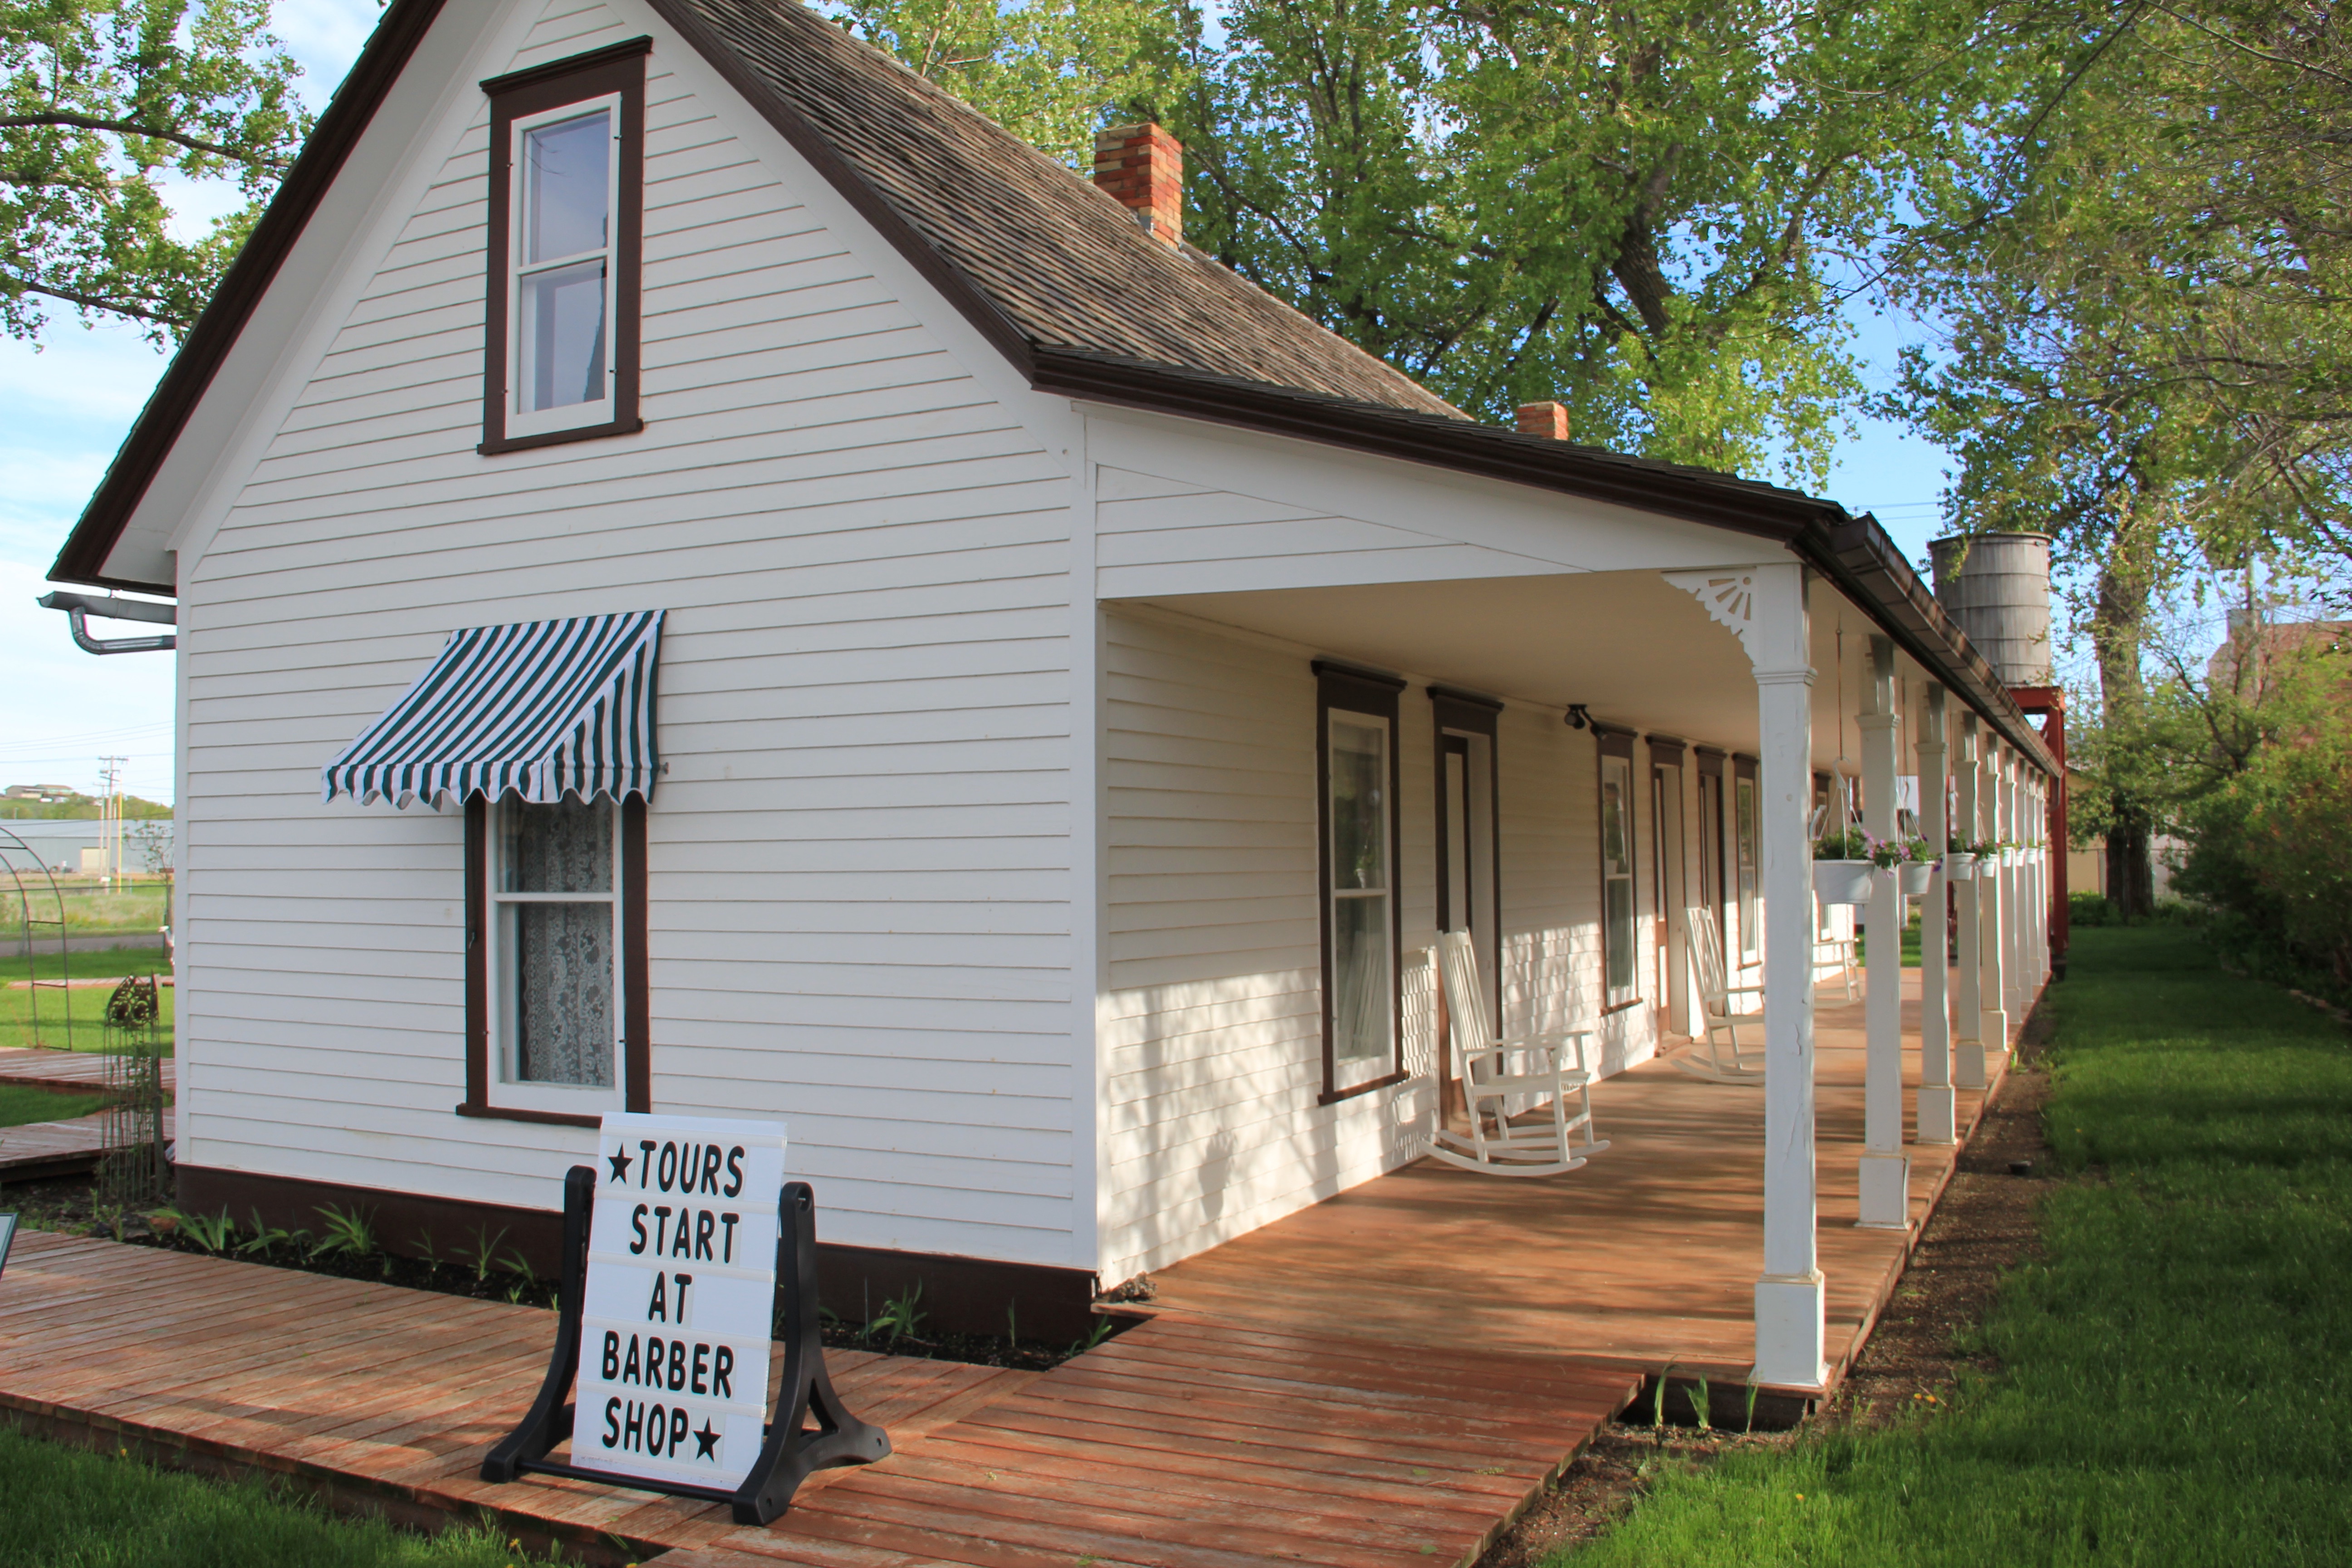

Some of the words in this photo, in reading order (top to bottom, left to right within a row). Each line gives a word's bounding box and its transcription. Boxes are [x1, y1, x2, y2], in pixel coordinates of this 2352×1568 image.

[640, 1140, 745, 1198] TOURS
[629, 1203, 740, 1264] START
[648, 1271, 693, 1324] AT
[602, 1330, 734, 1399] BARBER
[602, 1396, 689, 1458] SHOP
